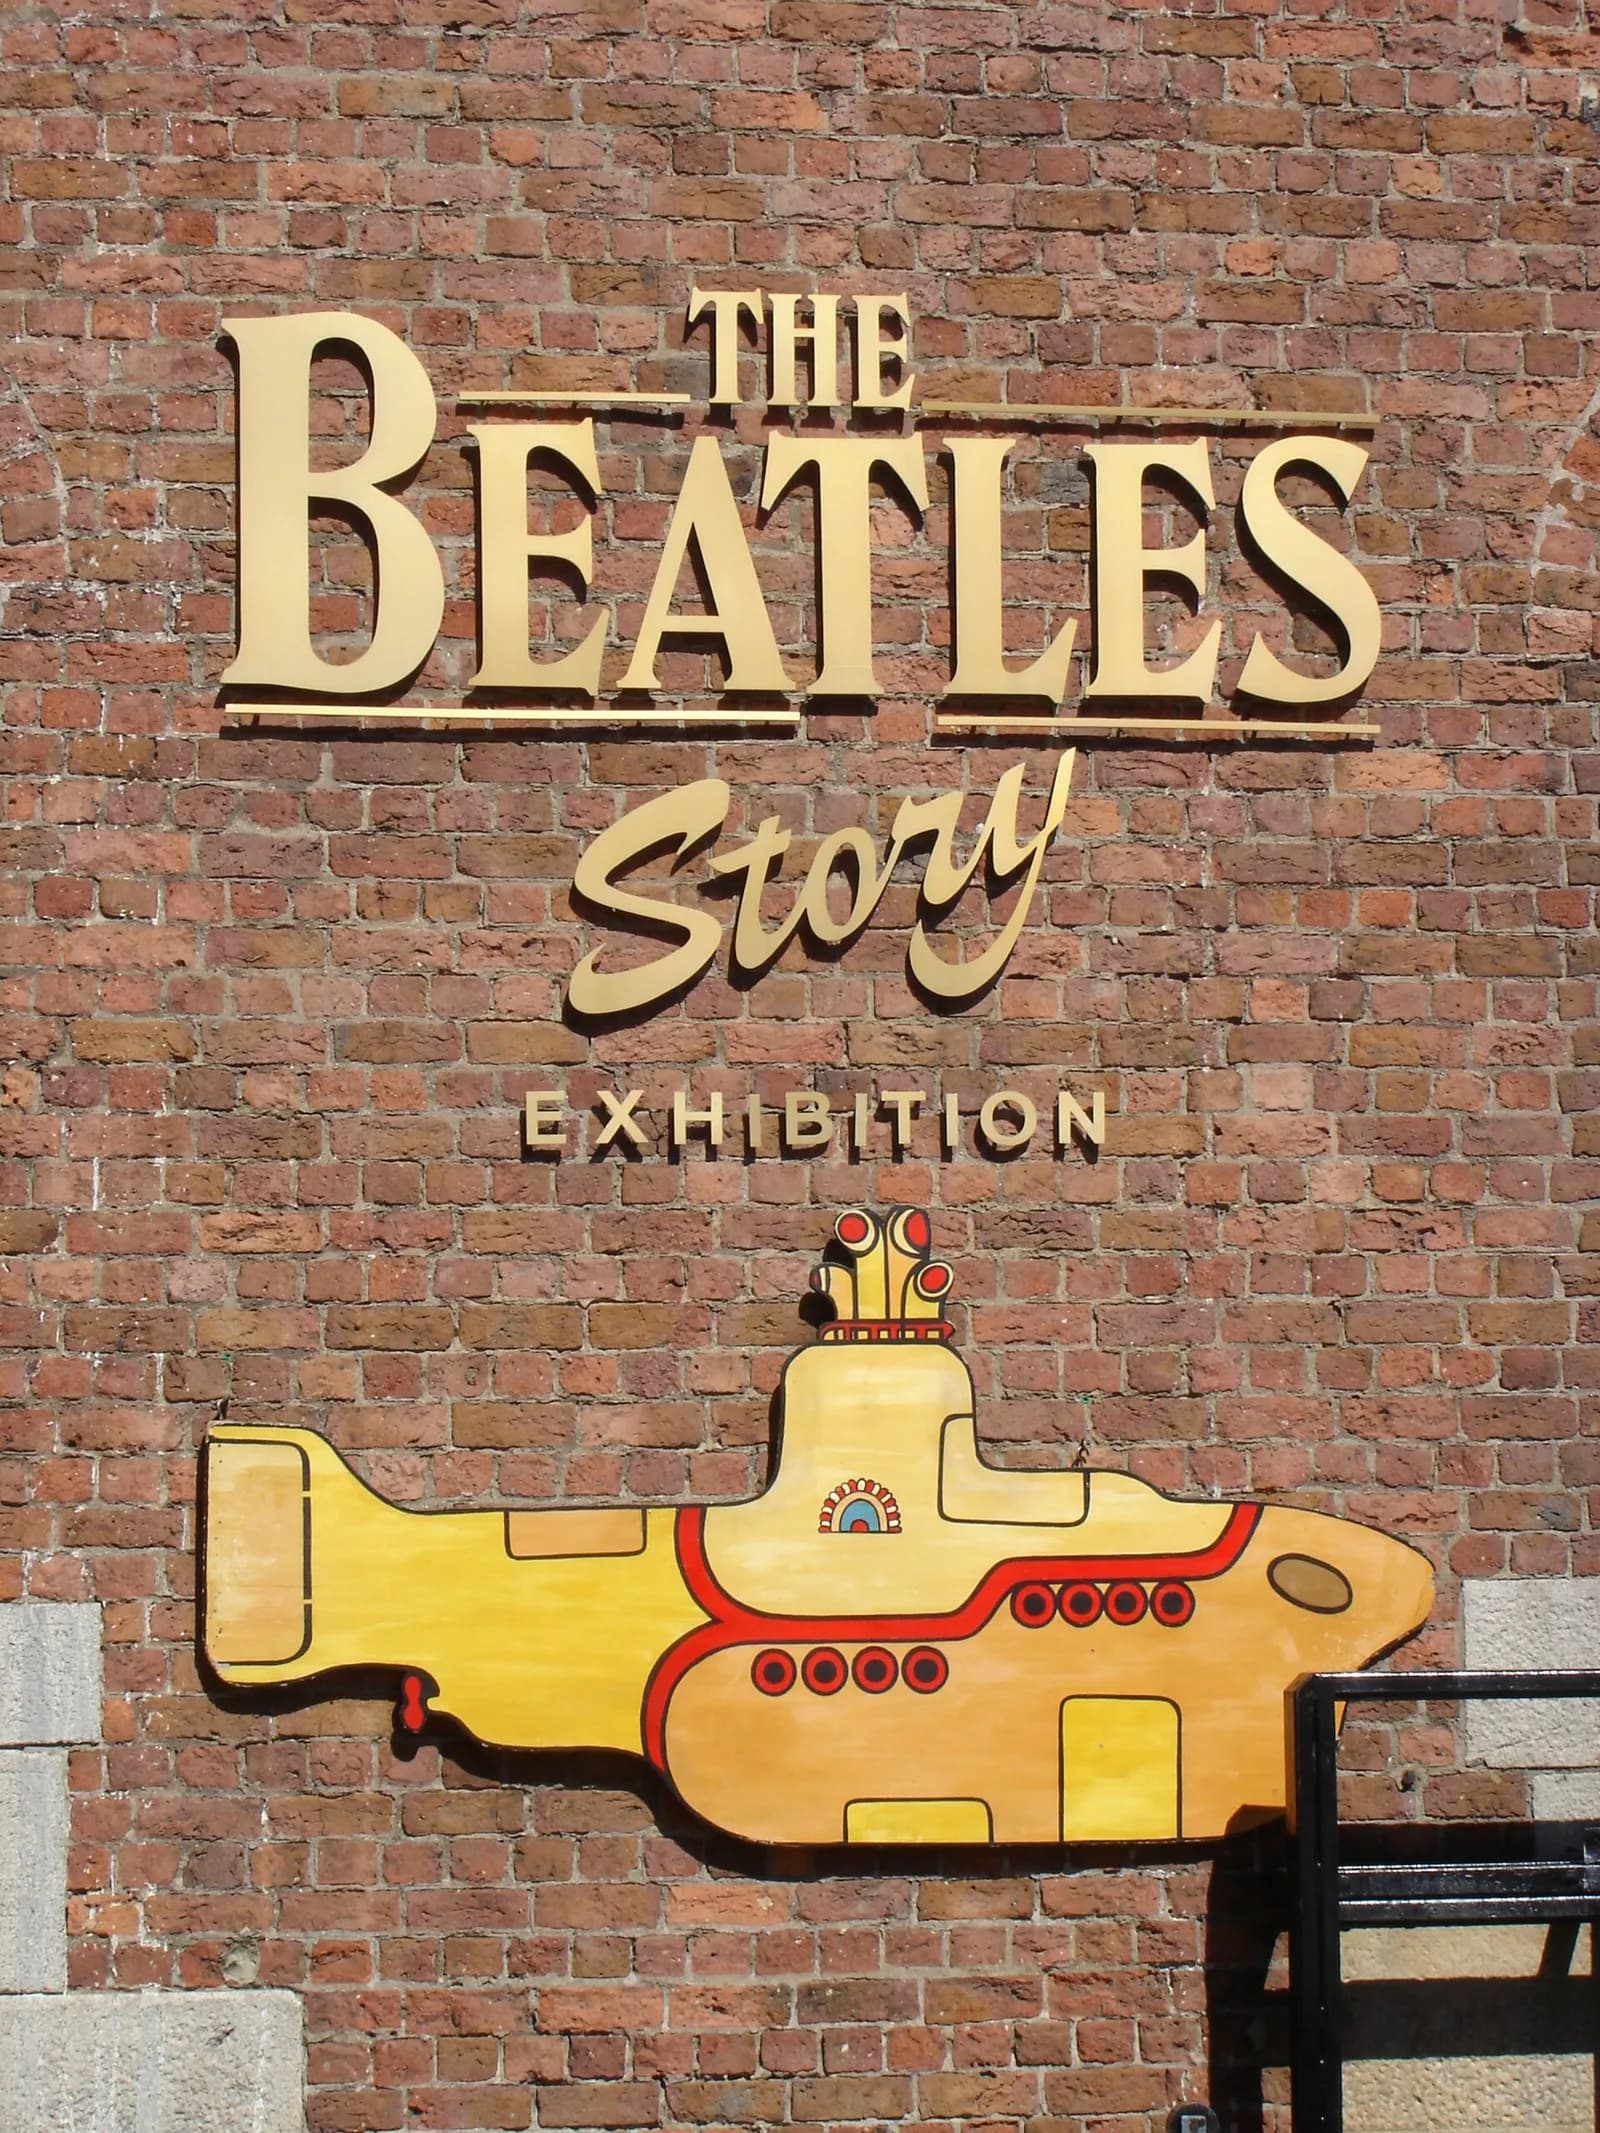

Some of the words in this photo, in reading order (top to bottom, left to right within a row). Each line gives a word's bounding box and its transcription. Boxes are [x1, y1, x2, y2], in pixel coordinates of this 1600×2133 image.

[687, 288, 916, 411] THE
[220, 311, 1382, 703] BEATLES
[568, 747, 1076, 1014] Story
[525, 1090, 1106, 1147] EXHIBITION
